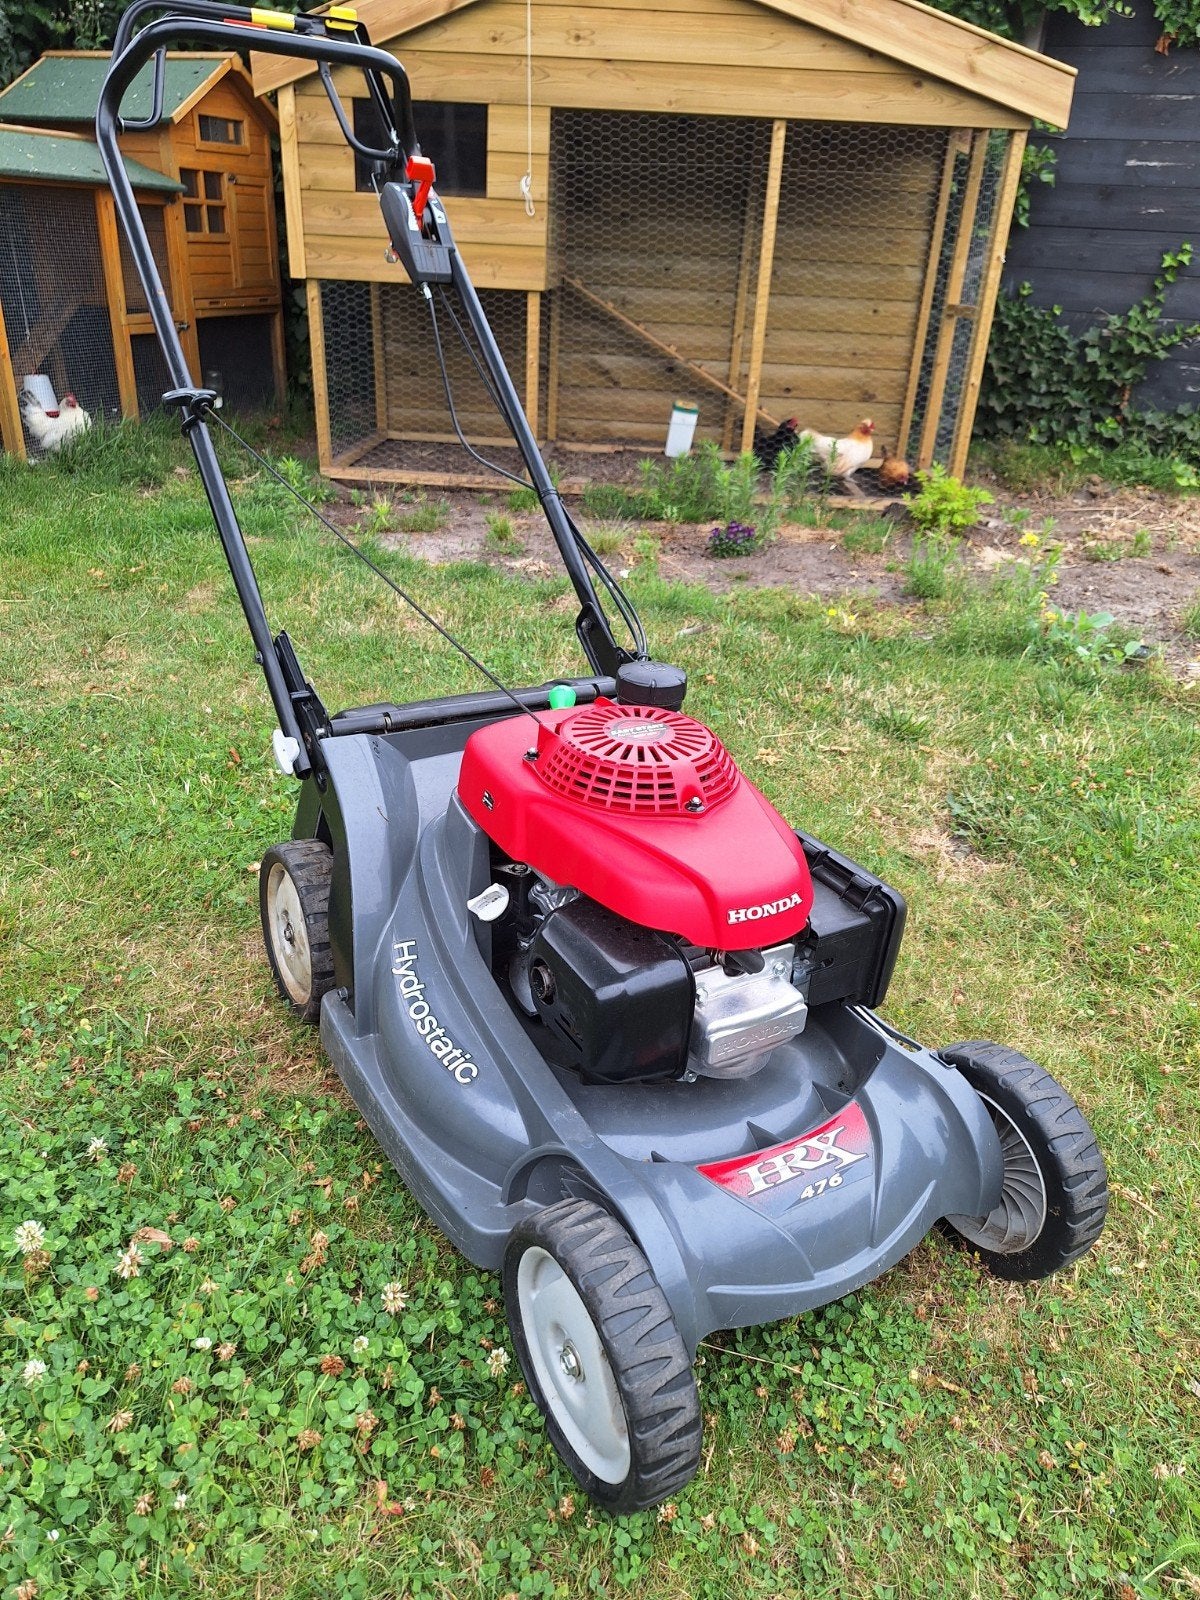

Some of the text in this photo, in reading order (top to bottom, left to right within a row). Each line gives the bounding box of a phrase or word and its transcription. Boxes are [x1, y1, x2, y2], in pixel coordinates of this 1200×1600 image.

[727, 893, 803, 924] HONDA
[391, 939, 479, 1084] Hydrostatic
[717, 1022, 800, 1056] HONDA
[737, 1125, 870, 1198] HRX
[800, 1173, 844, 1200] 476
